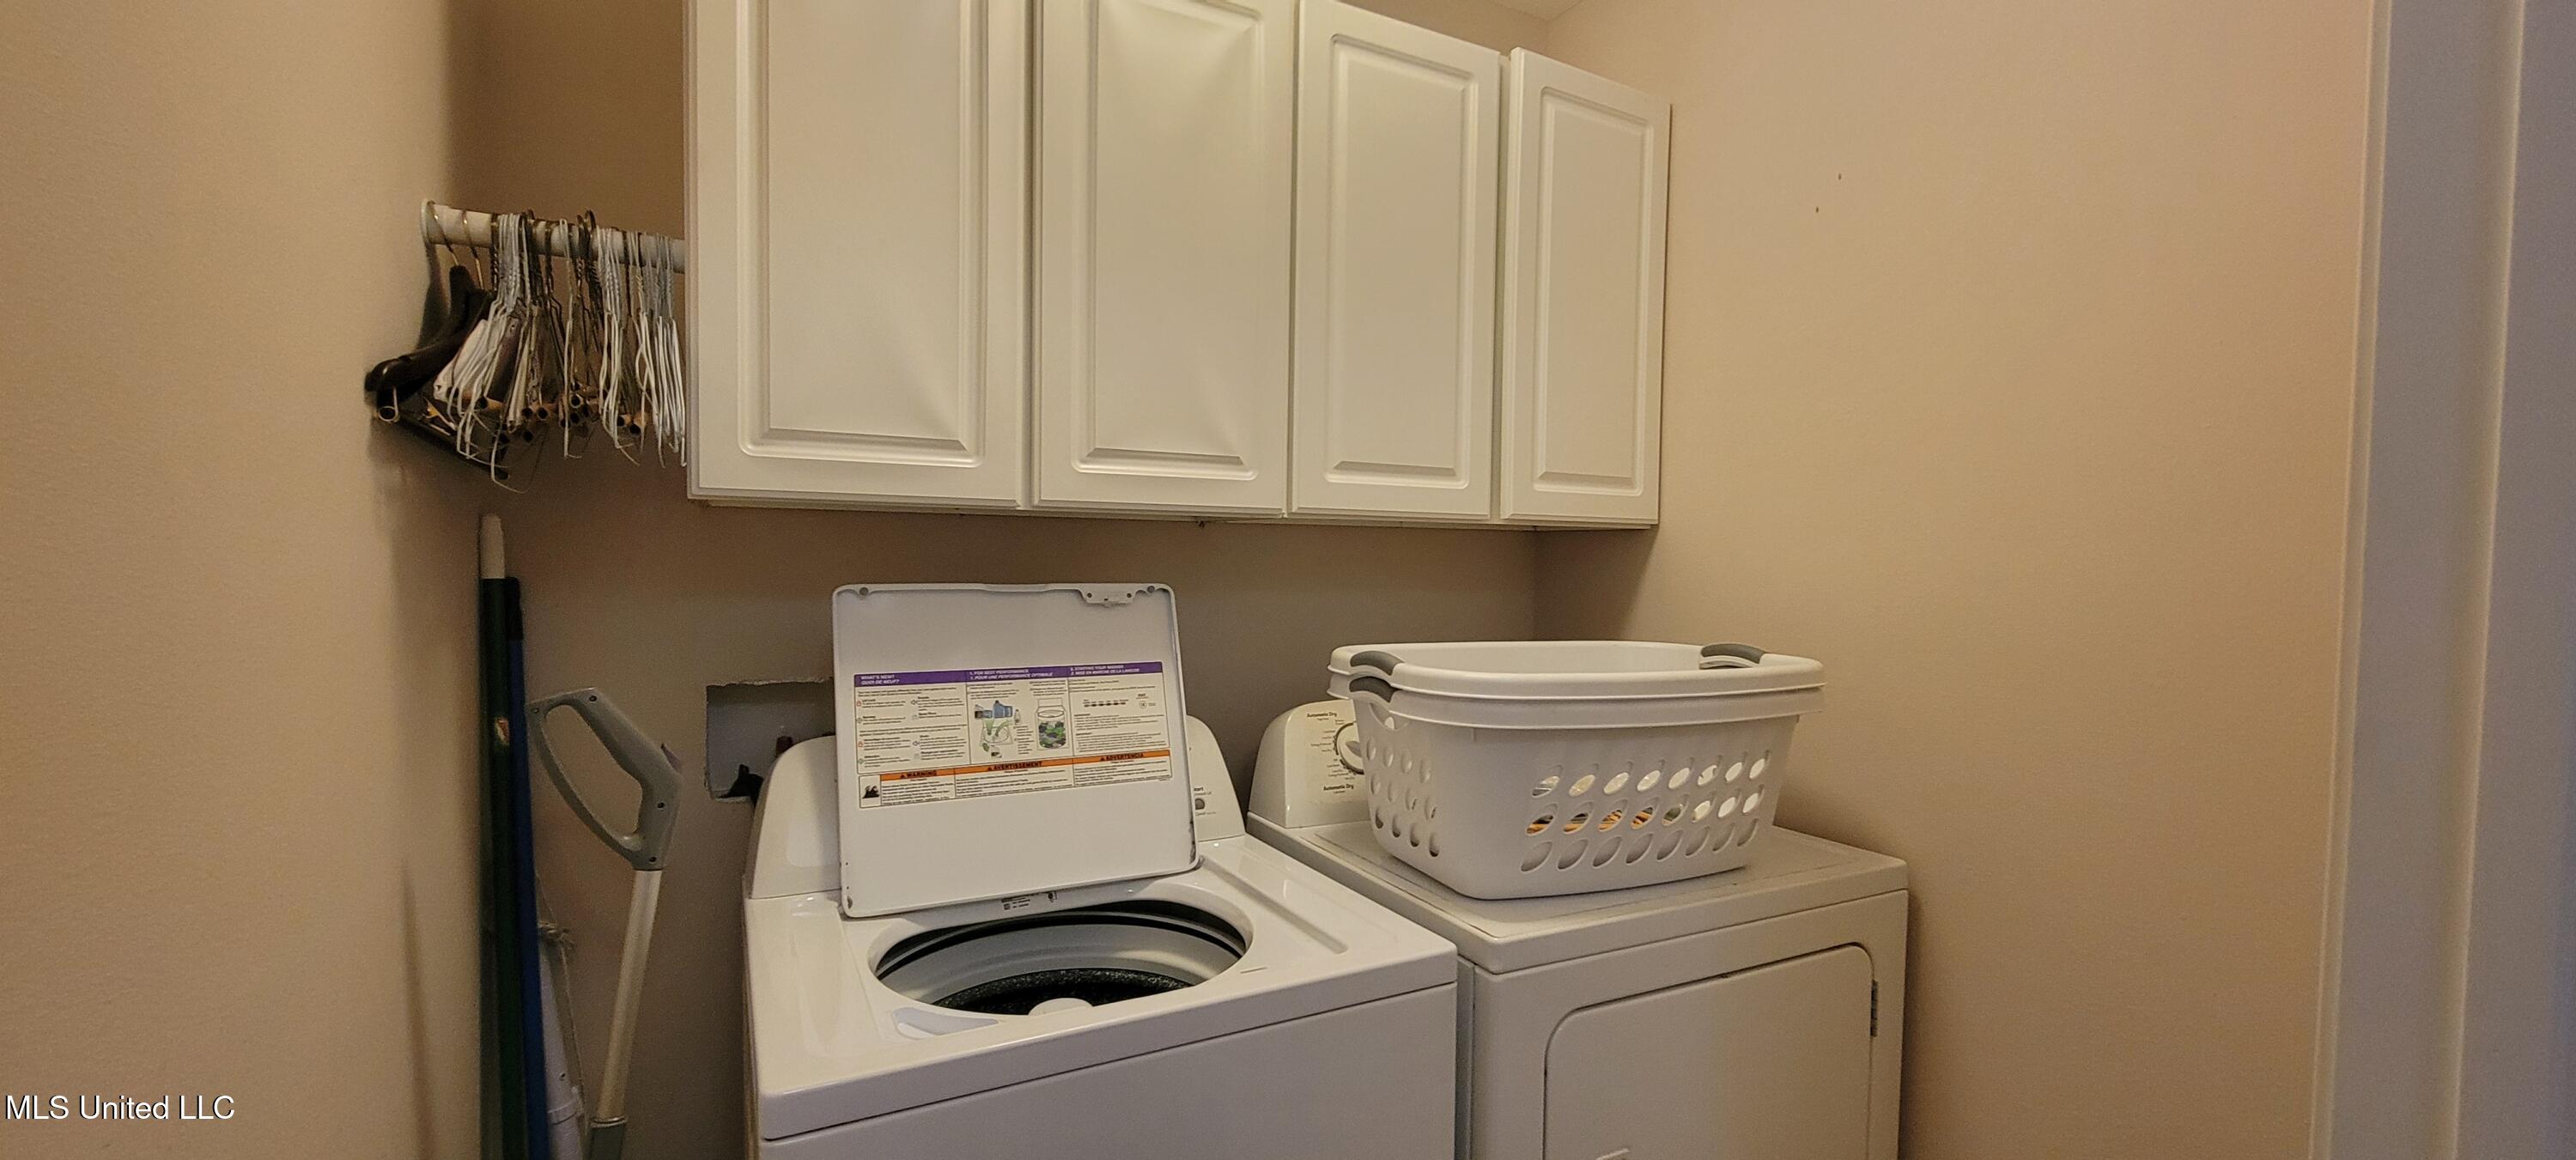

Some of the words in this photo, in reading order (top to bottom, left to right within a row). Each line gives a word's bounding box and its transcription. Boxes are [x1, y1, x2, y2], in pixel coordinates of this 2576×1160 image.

[1106, 752, 1144, 762] ADVERTENCIA
[993, 761, 1042, 771] AVERTISSEMENT
[907, 769, 937, 779] WARNING
